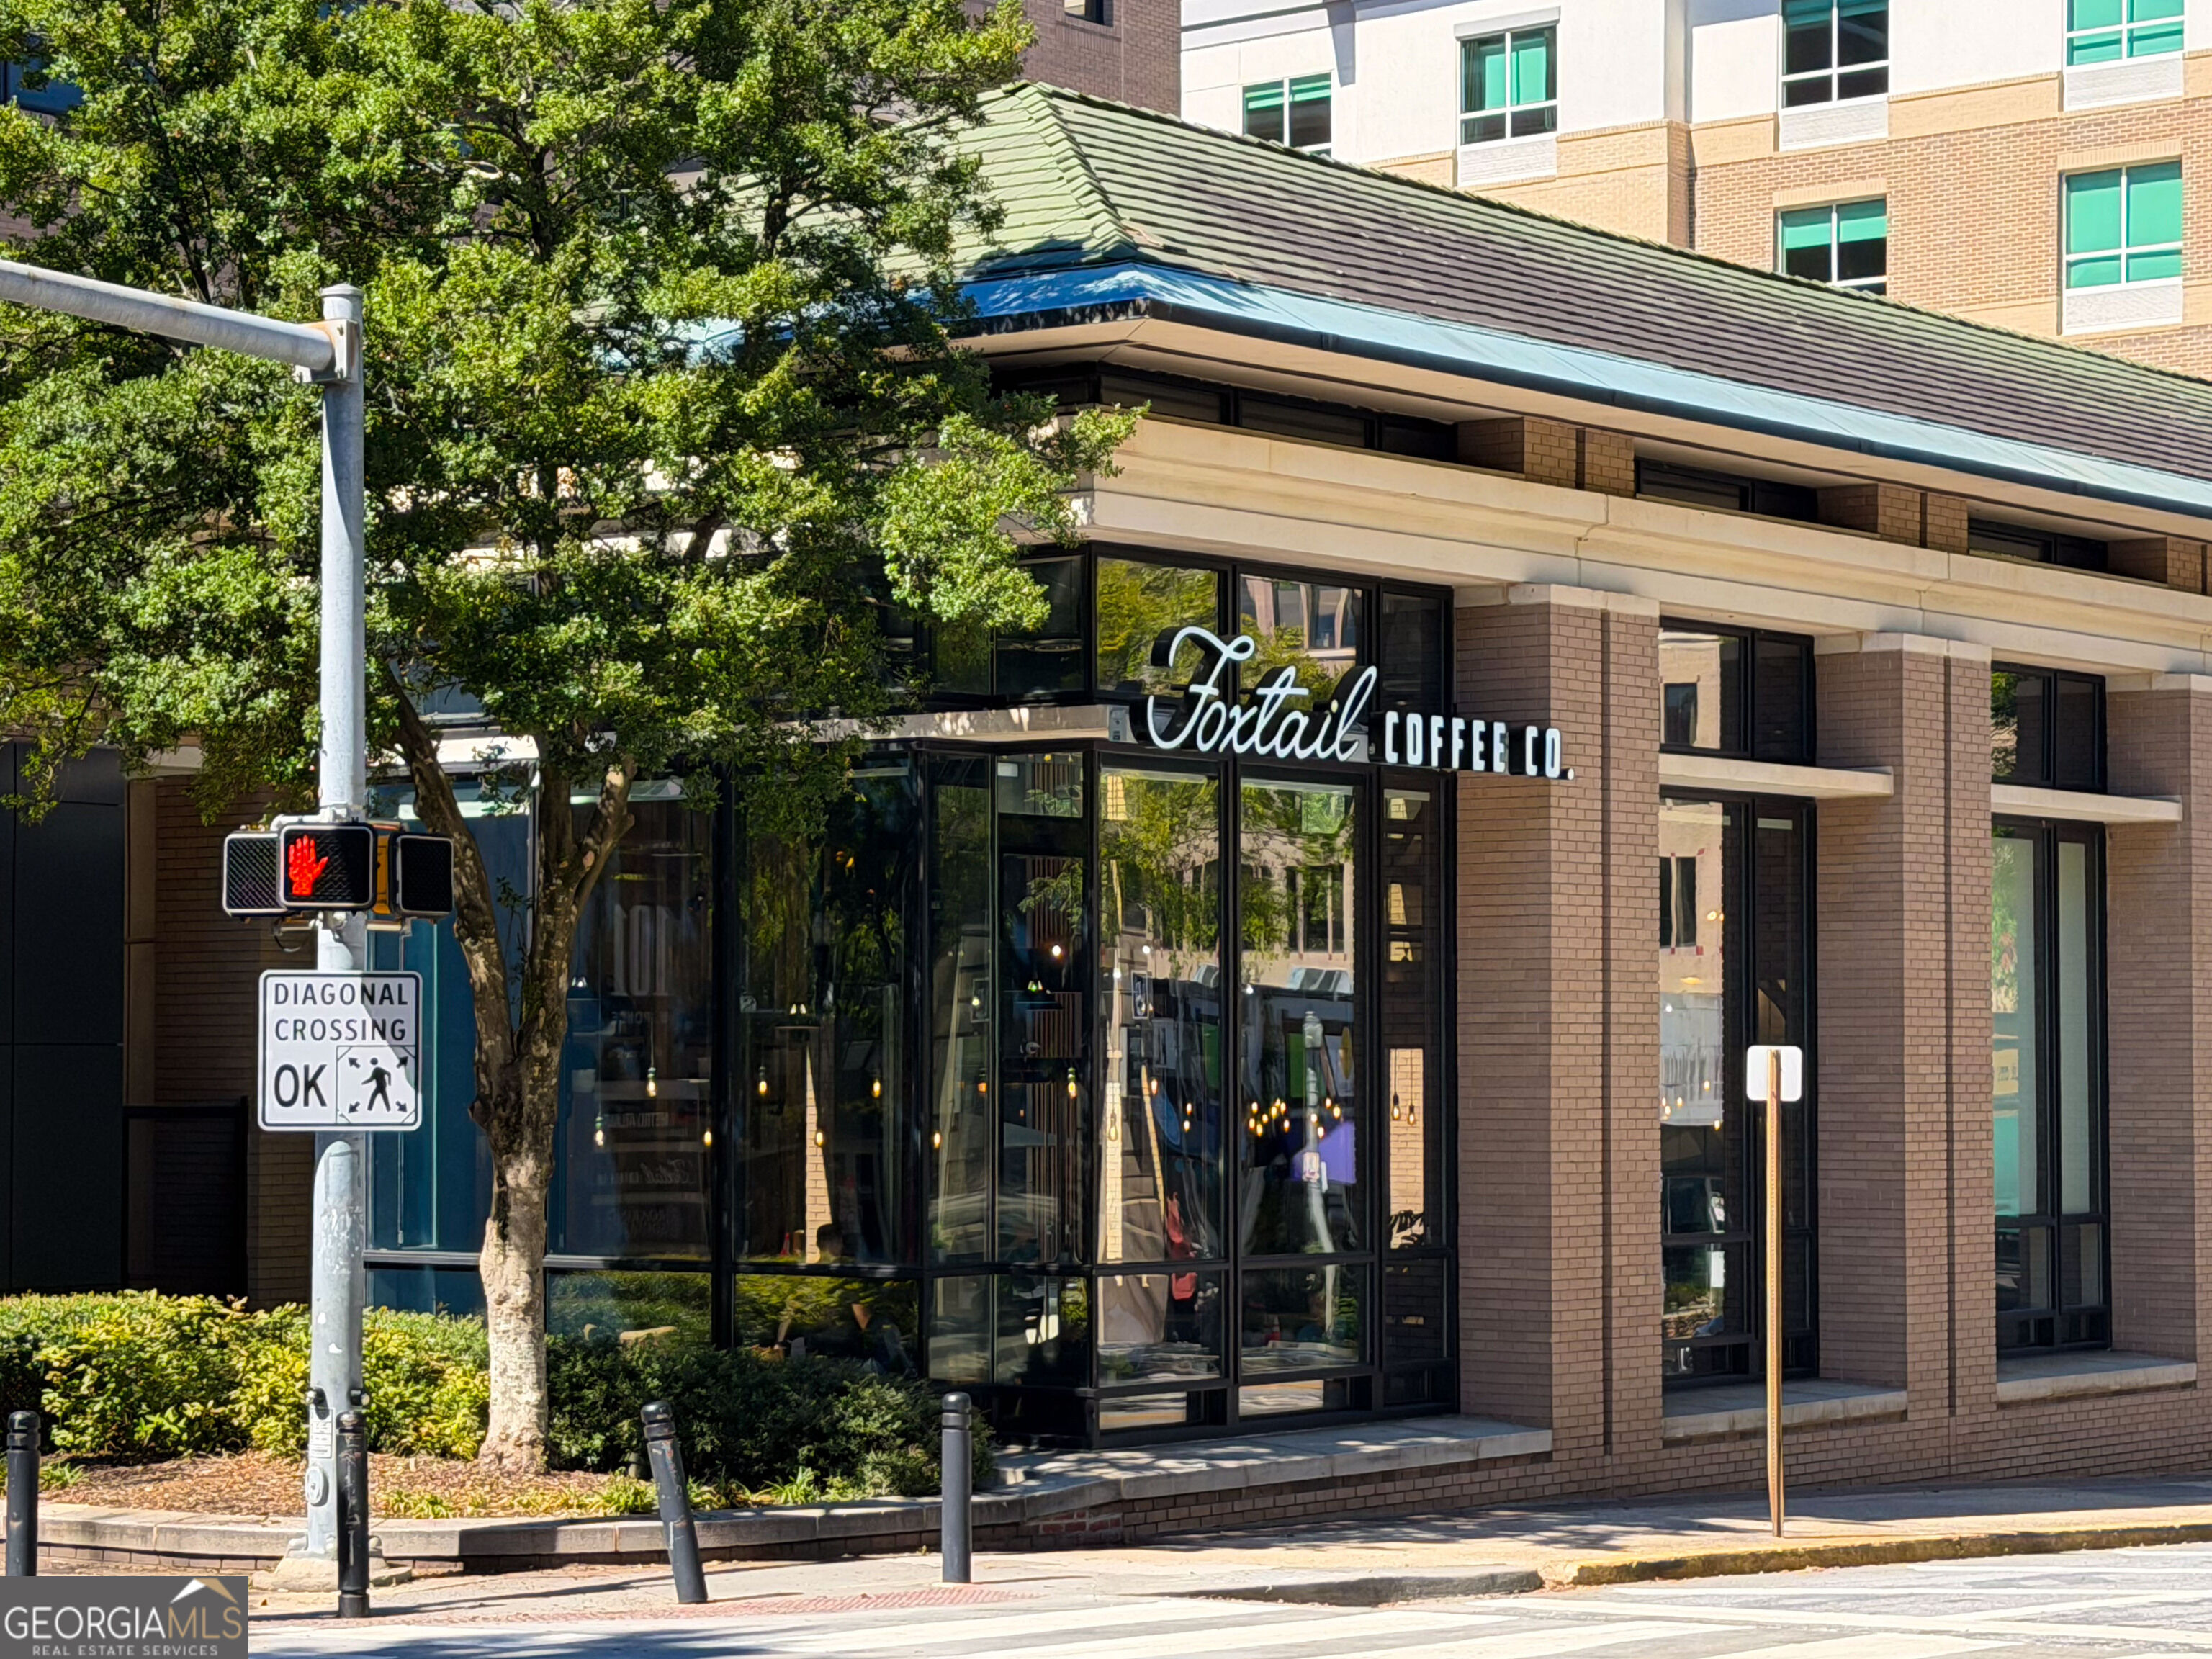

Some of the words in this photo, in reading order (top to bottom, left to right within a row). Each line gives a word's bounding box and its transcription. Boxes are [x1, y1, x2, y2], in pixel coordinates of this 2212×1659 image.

[1147, 625, 1377, 762] Foxtail
[1385, 710, 1508, 773] COFFEE
[1524, 724, 1575, 781] CO.
[274, 983, 408, 1005] DIAGONAL
[275, 1018, 406, 1041] CROSSING
[274, 1064, 328, 1107] OK
